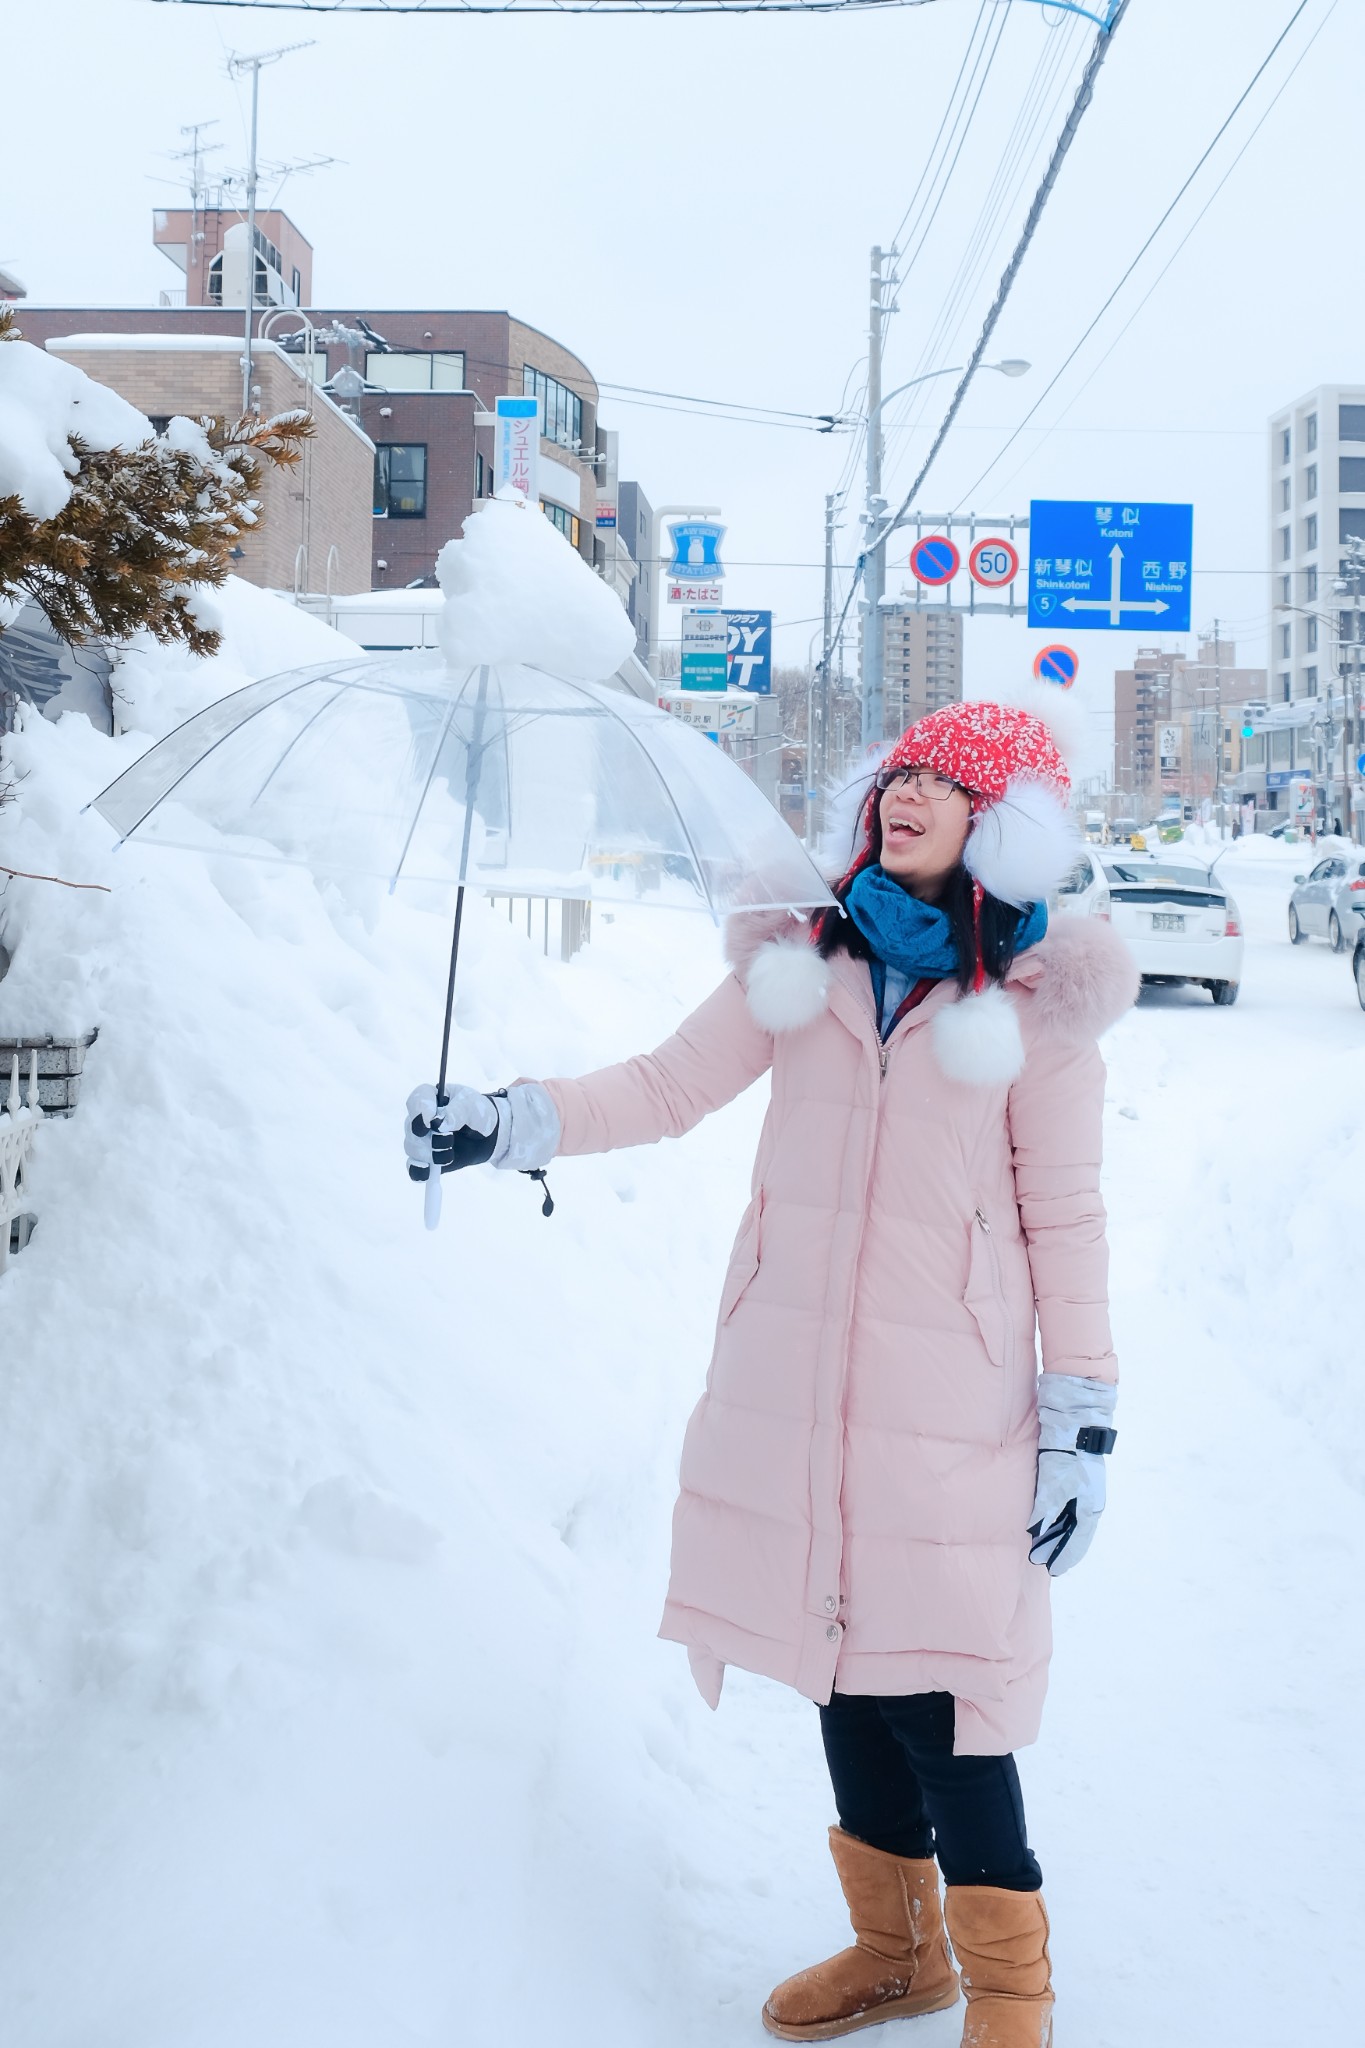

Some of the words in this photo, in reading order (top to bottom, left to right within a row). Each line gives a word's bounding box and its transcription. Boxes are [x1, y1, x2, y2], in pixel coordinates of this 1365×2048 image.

[512, 419, 530, 499] ジュエル歯
[1095, 506, 1140, 525] 琴似
[674, 526, 719, 537] LAWSON
[1100, 528, 1134, 538] Kotoni
[673, 563, 717, 575] STATION
[980, 552, 1007, 574] 50
[1033, 558, 1093, 577] 新琴似
[1142, 561, 1187, 580] 西野
[1036, 578, 1090, 590] Shinkotoni
[1145, 582, 1183, 592] Nishino
[1040, 597, 1049, 610] 5
[675, 701, 682, 711] 3
[674, 714, 712, 723] の沢駅
